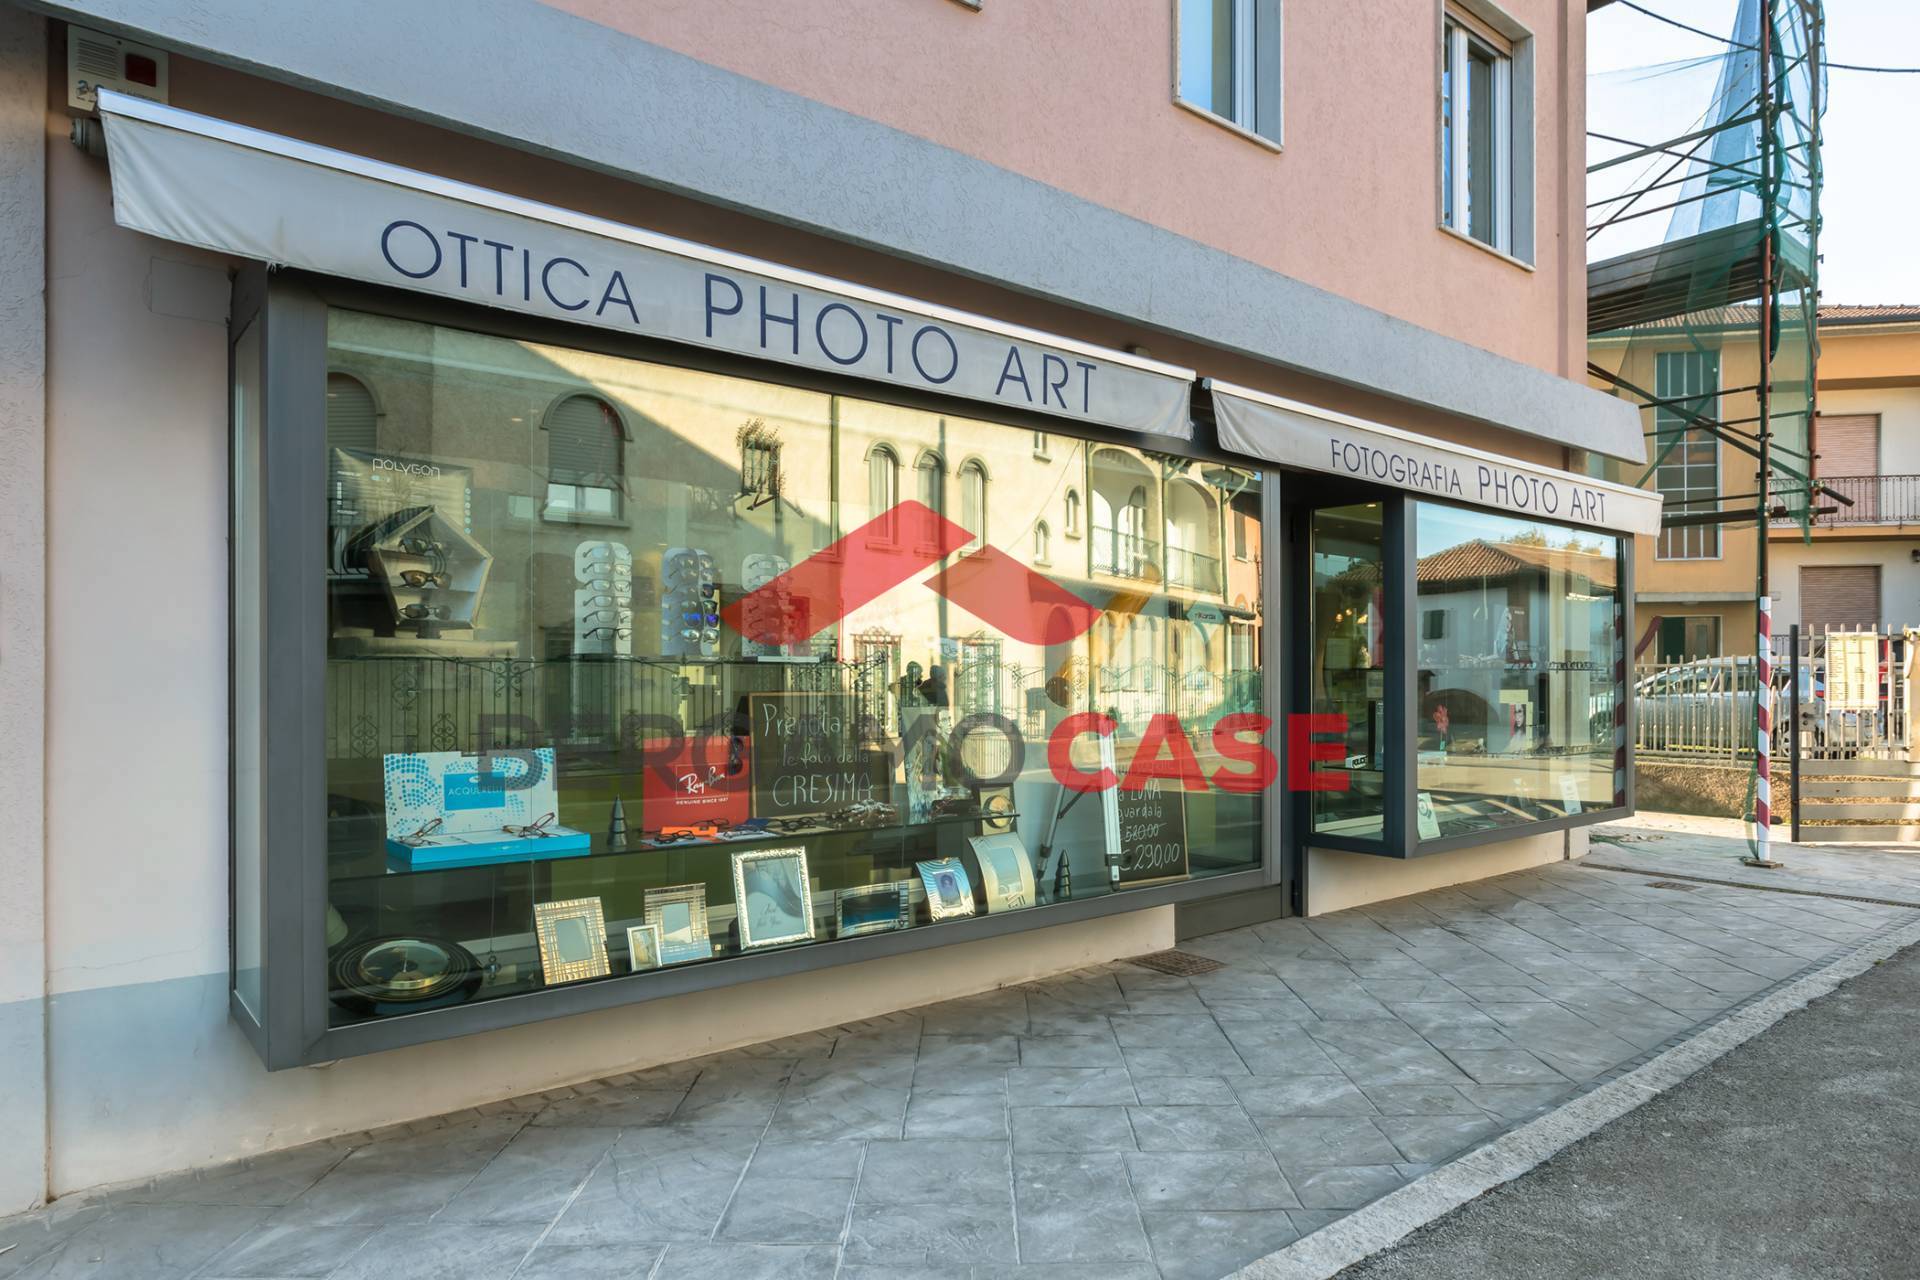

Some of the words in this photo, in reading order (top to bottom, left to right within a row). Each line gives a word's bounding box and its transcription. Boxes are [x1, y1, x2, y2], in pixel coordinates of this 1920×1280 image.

[381, 220, 640, 325] OTTICA
[704, 272, 958, 384] PHOTO
[995, 345, 1097, 413] ART
[1330, 438, 1463, 496] FOTOGRAFIA
[1478, 465, 1559, 515] PHOTO
[1570, 487, 1606, 523] ART
[763, 703, 841, 737] Prenota
[772, 771, 874, 807] CRESIMA
[1125, 822, 1167, 842] 58000
[1133, 842, 1180, 870] 290,00
